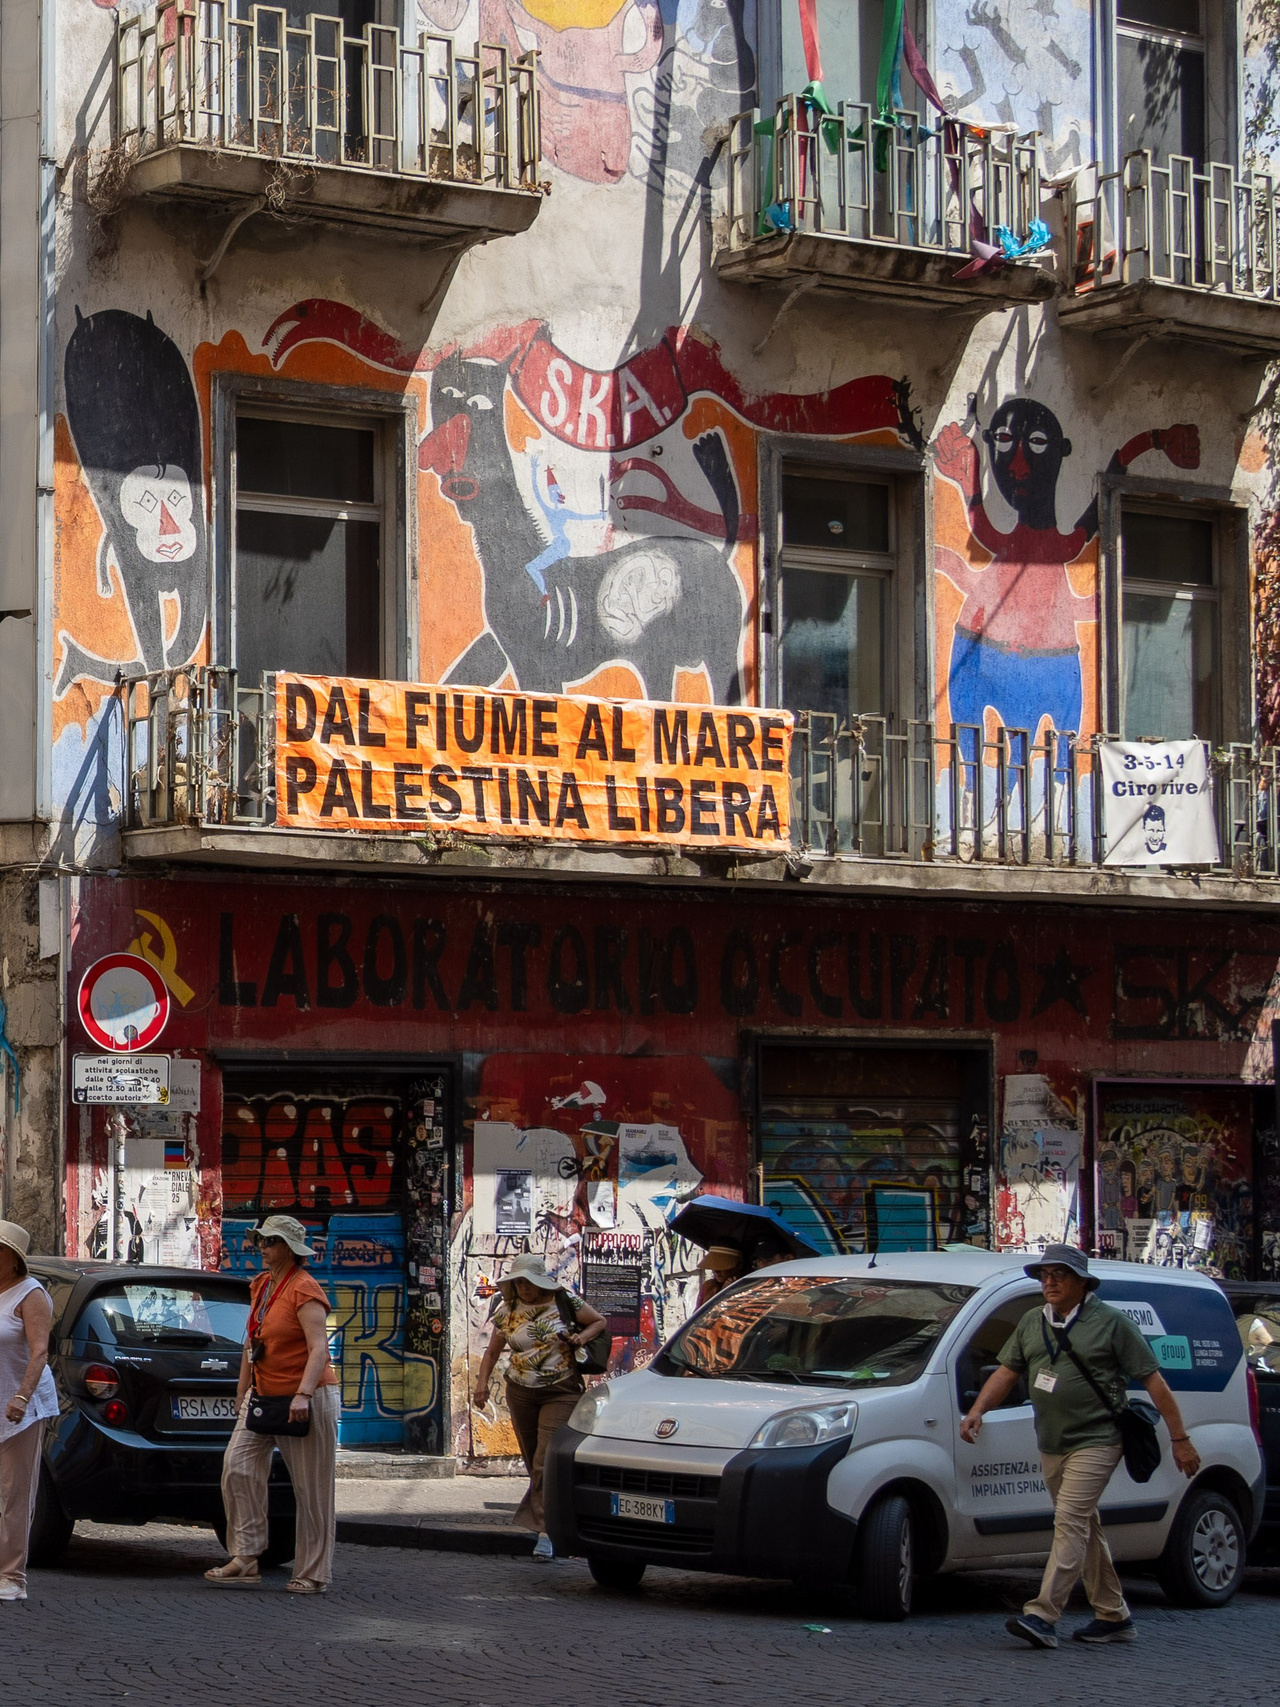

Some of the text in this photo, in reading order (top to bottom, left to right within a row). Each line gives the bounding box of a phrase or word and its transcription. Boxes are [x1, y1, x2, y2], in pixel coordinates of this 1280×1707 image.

[286, 683, 786, 772] DAL FIUME AL MARE
[1123, 753, 1185, 770] 3-5-14
[1112, 778, 1198, 797] Ciro vive
[286, 756, 781, 840] PALESTINA LIBERA
[218, 912, 1022, 1024] LABORATORIO OCCUPATO
[1161, 1343, 1186, 1361] group
[180, 1399, 208, 1417] RSA
[971, 1462, 1037, 1477] ASSISTENZA e
[972, 1480, 1047, 1498] IMPIANTI SPINA
[620, 1498, 631, 1513] EG
[634, 1500, 665, 1519] 388KY
